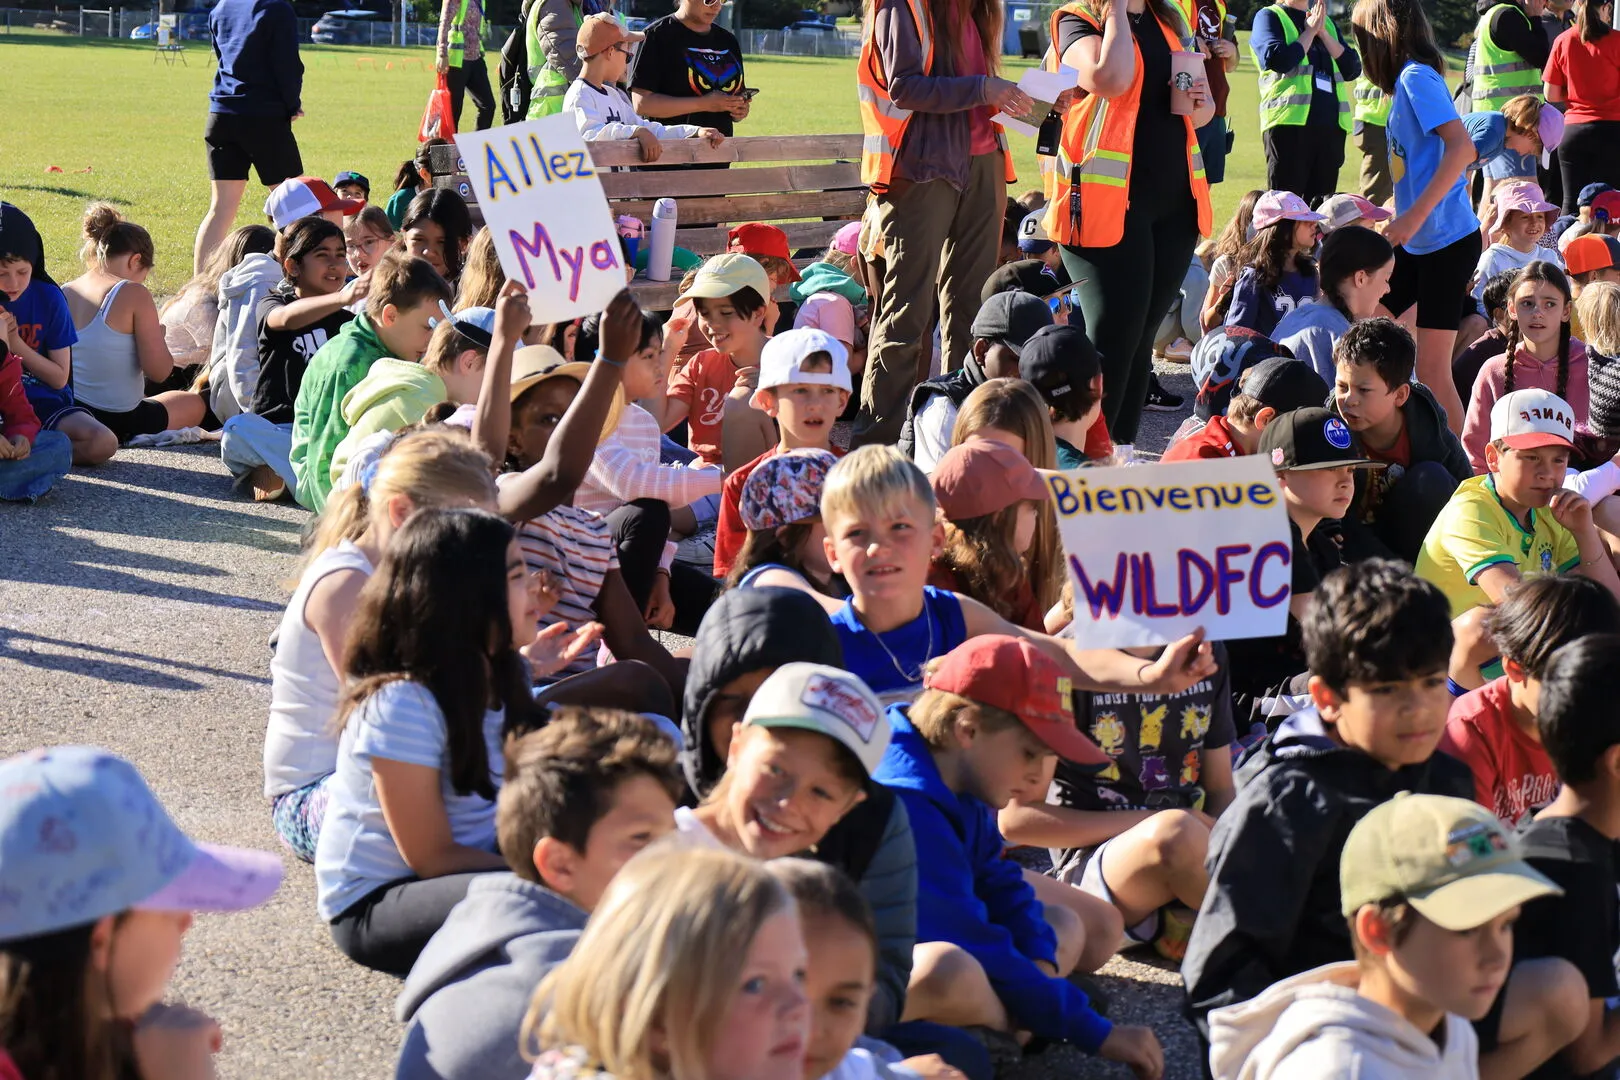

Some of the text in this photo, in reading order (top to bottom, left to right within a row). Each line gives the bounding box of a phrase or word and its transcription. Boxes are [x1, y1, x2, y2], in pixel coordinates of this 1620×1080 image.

[483, 135, 594, 199] Allez
[1024, 218, 1037, 235] C
[508, 222, 619, 302] Mya
[1047, 474, 1276, 517] Bienvenue
